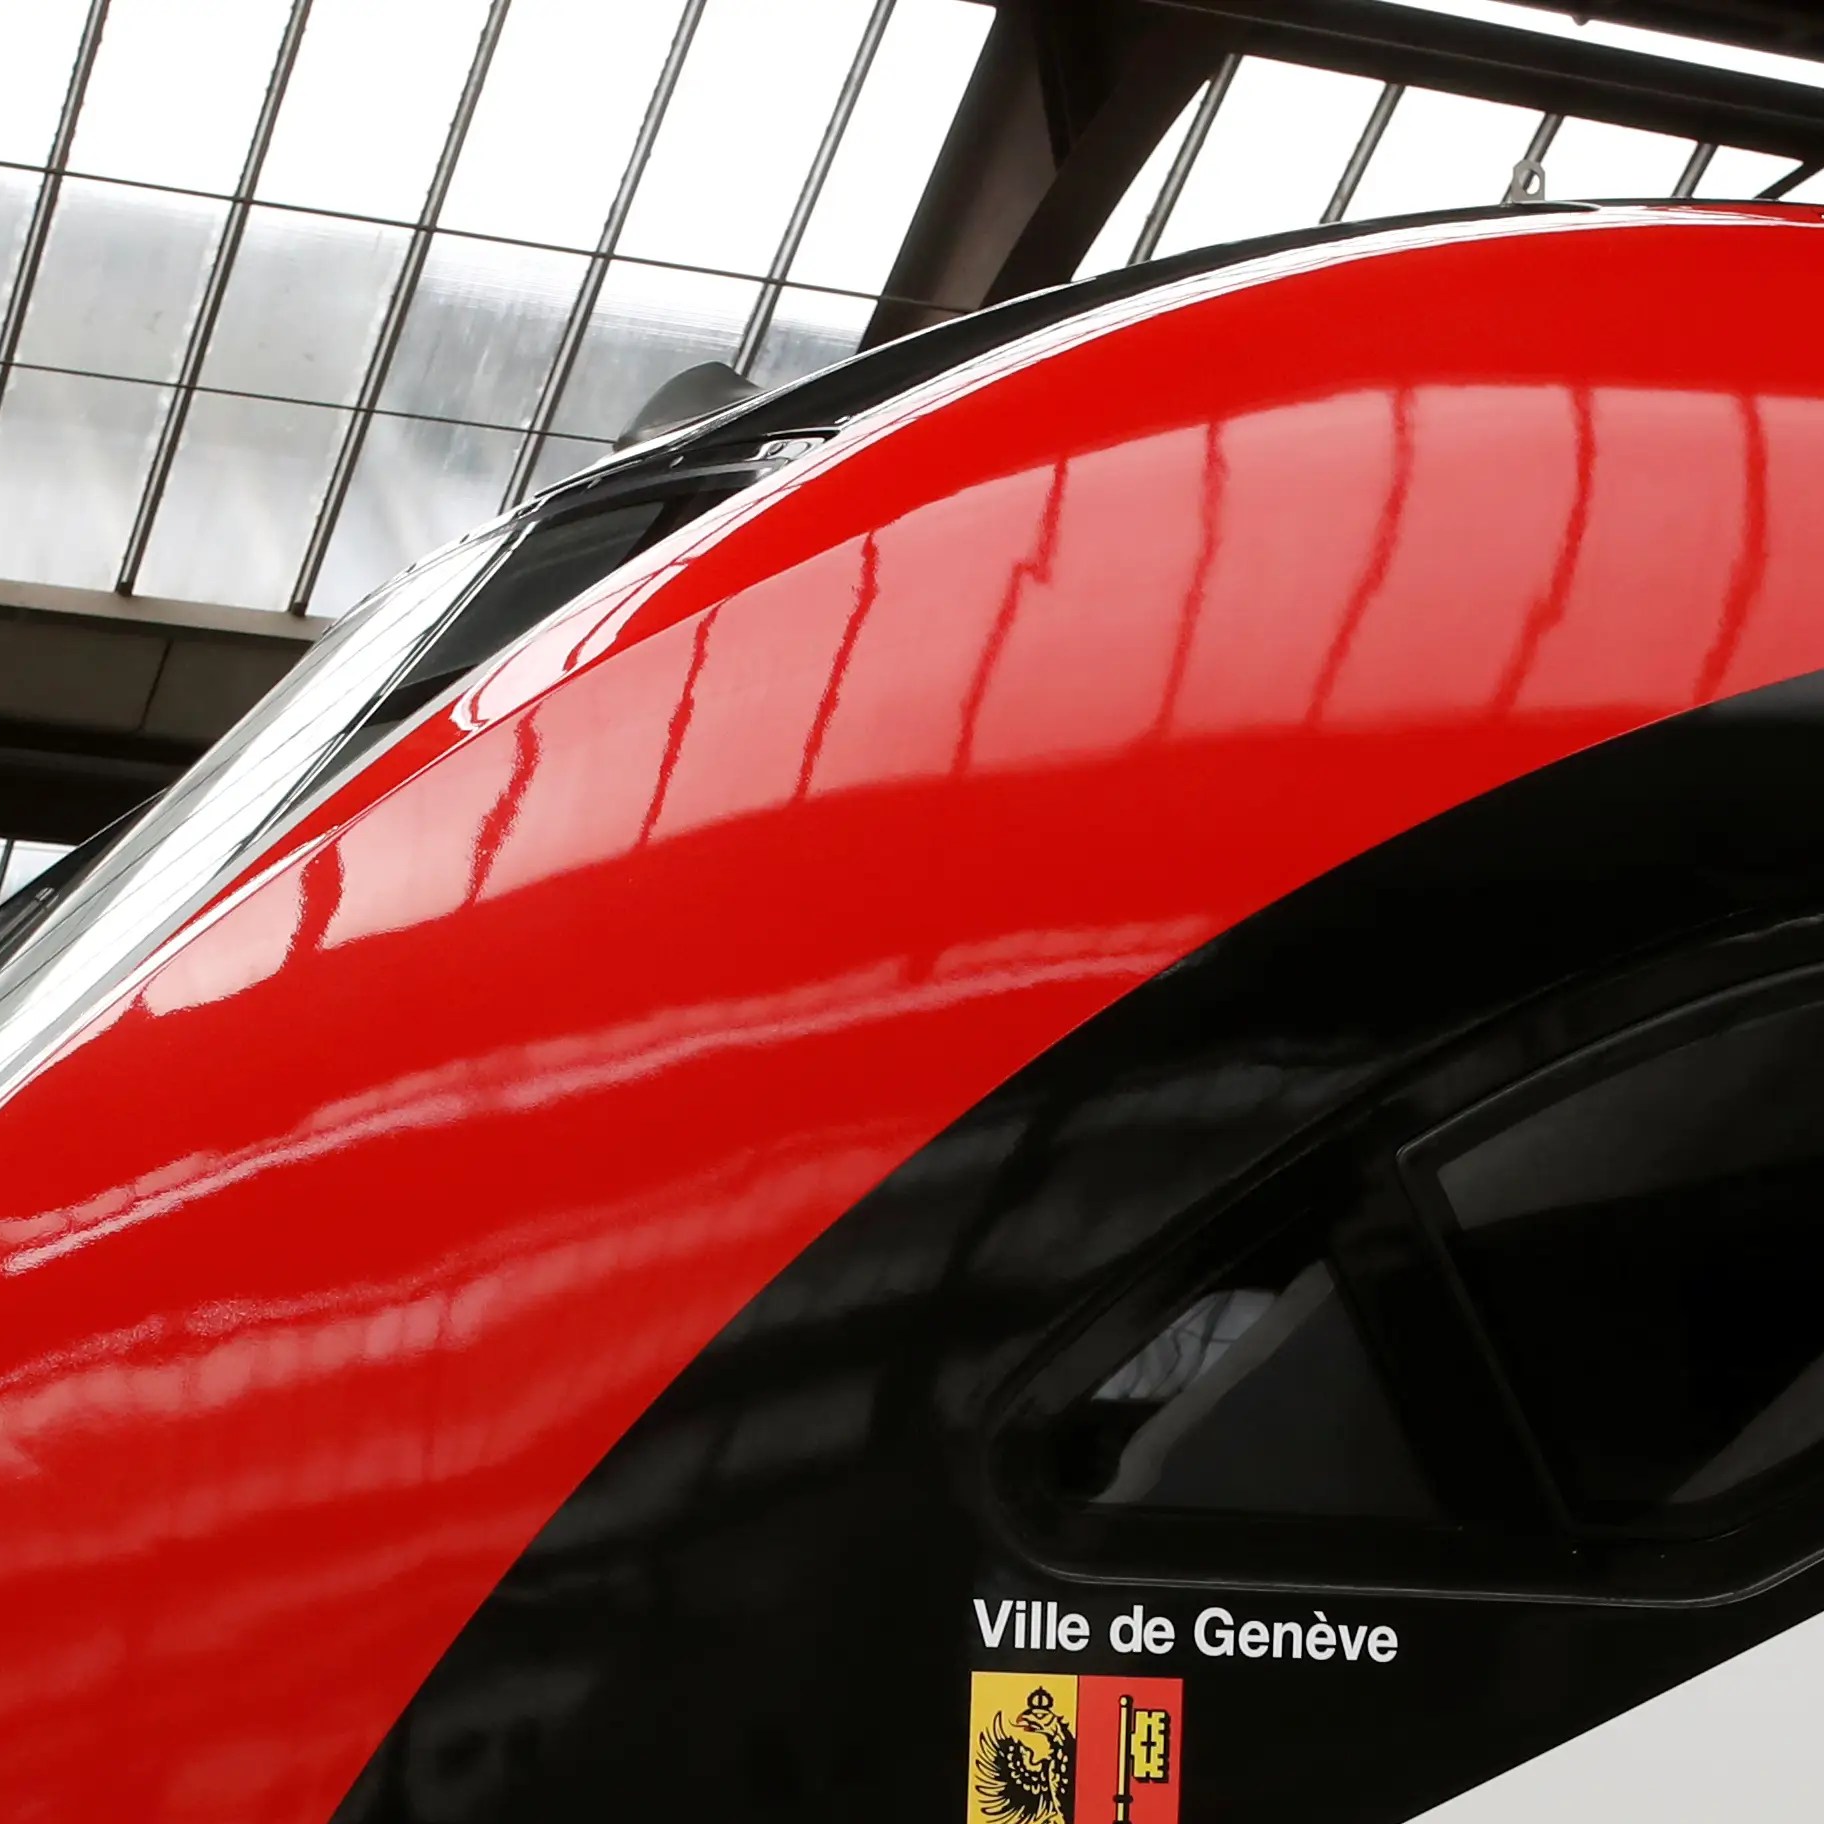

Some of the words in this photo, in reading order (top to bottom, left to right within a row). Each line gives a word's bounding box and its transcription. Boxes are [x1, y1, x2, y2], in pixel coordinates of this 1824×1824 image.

[972, 1598, 1090, 1652] Ville
[1109, 1604, 1176, 1655] de
[1193, 1606, 1399, 1663] Genève
